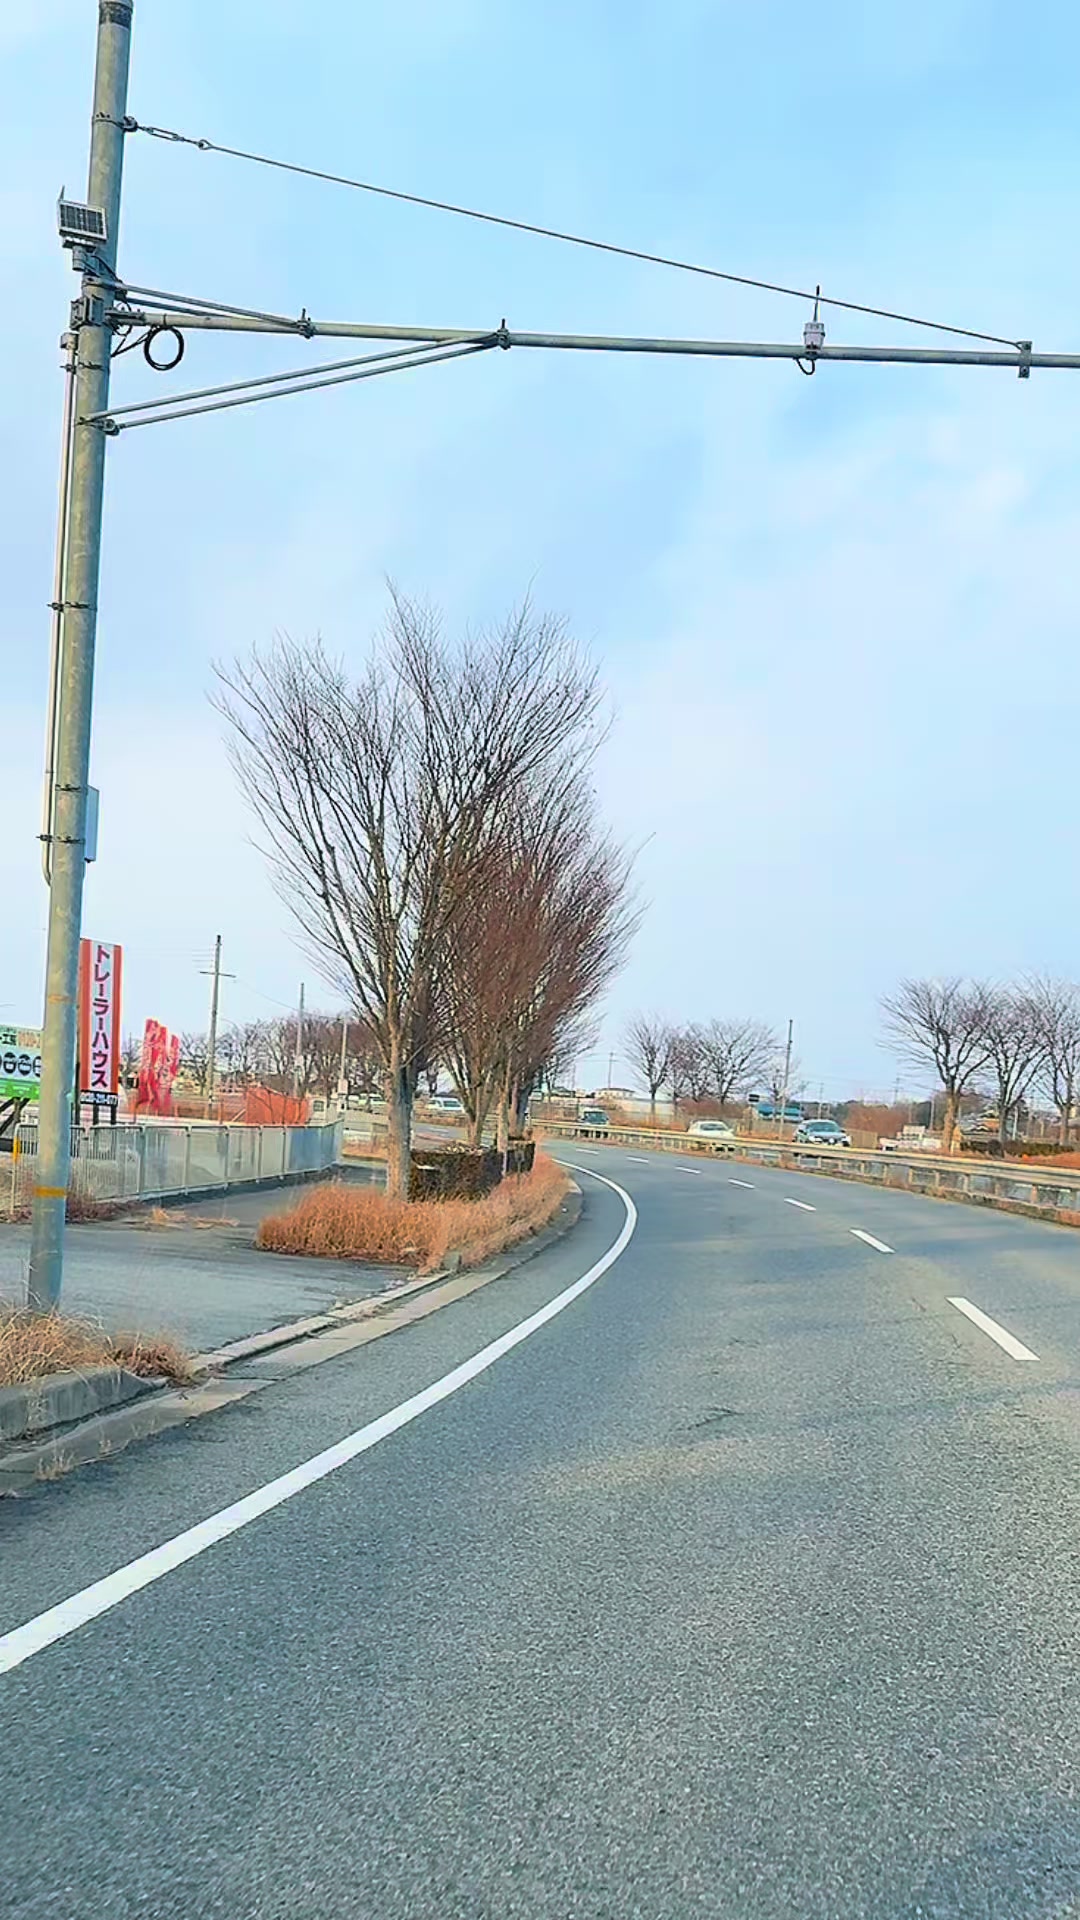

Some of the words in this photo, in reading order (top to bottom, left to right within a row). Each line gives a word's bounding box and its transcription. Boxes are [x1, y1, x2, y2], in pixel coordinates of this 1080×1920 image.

[91, 945, 110, 1087] トレーラーハウス
